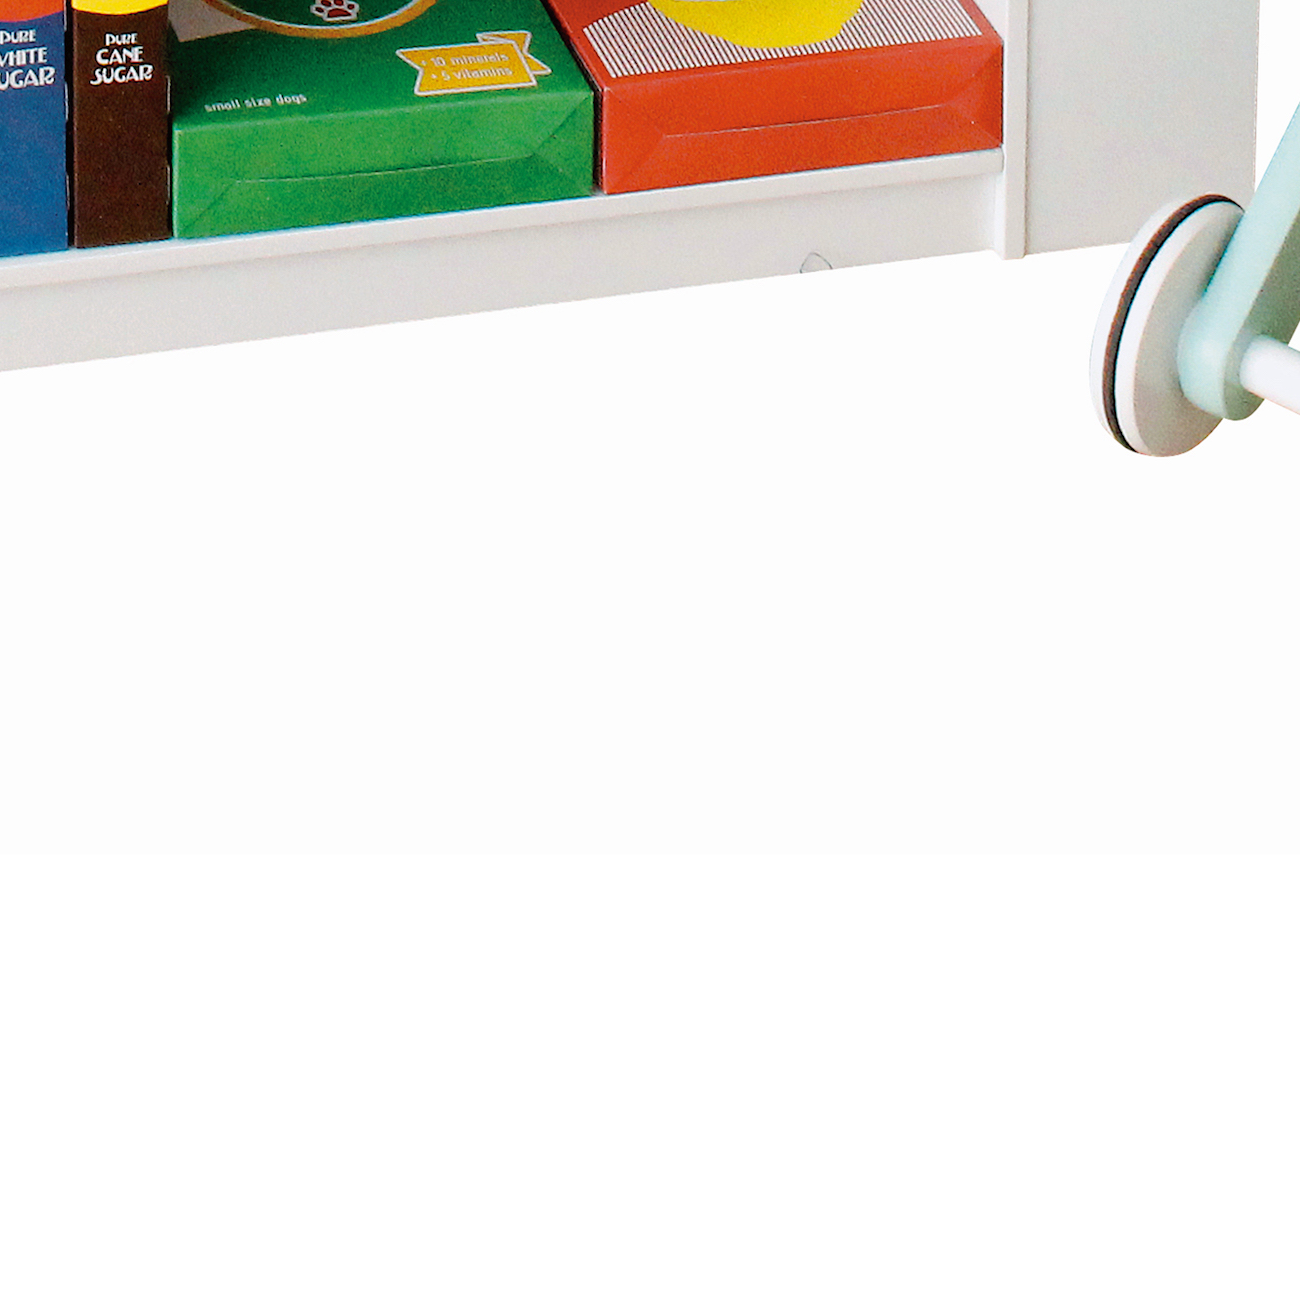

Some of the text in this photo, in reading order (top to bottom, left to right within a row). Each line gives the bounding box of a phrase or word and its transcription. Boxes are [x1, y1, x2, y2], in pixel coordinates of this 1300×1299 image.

[0, 29, 37, 45] PURE
[105, 33, 138, 46] PURE
[95, 45, 143, 66] CANE
[431, 56, 447, 67] 10
[450, 52, 509, 66] minerals
[89, 64, 153, 86] SUGAR
[441, 71, 451, 81] 5
[453, 67, 513, 80] vitamins
[204, 93, 307, 113] small size dogs
